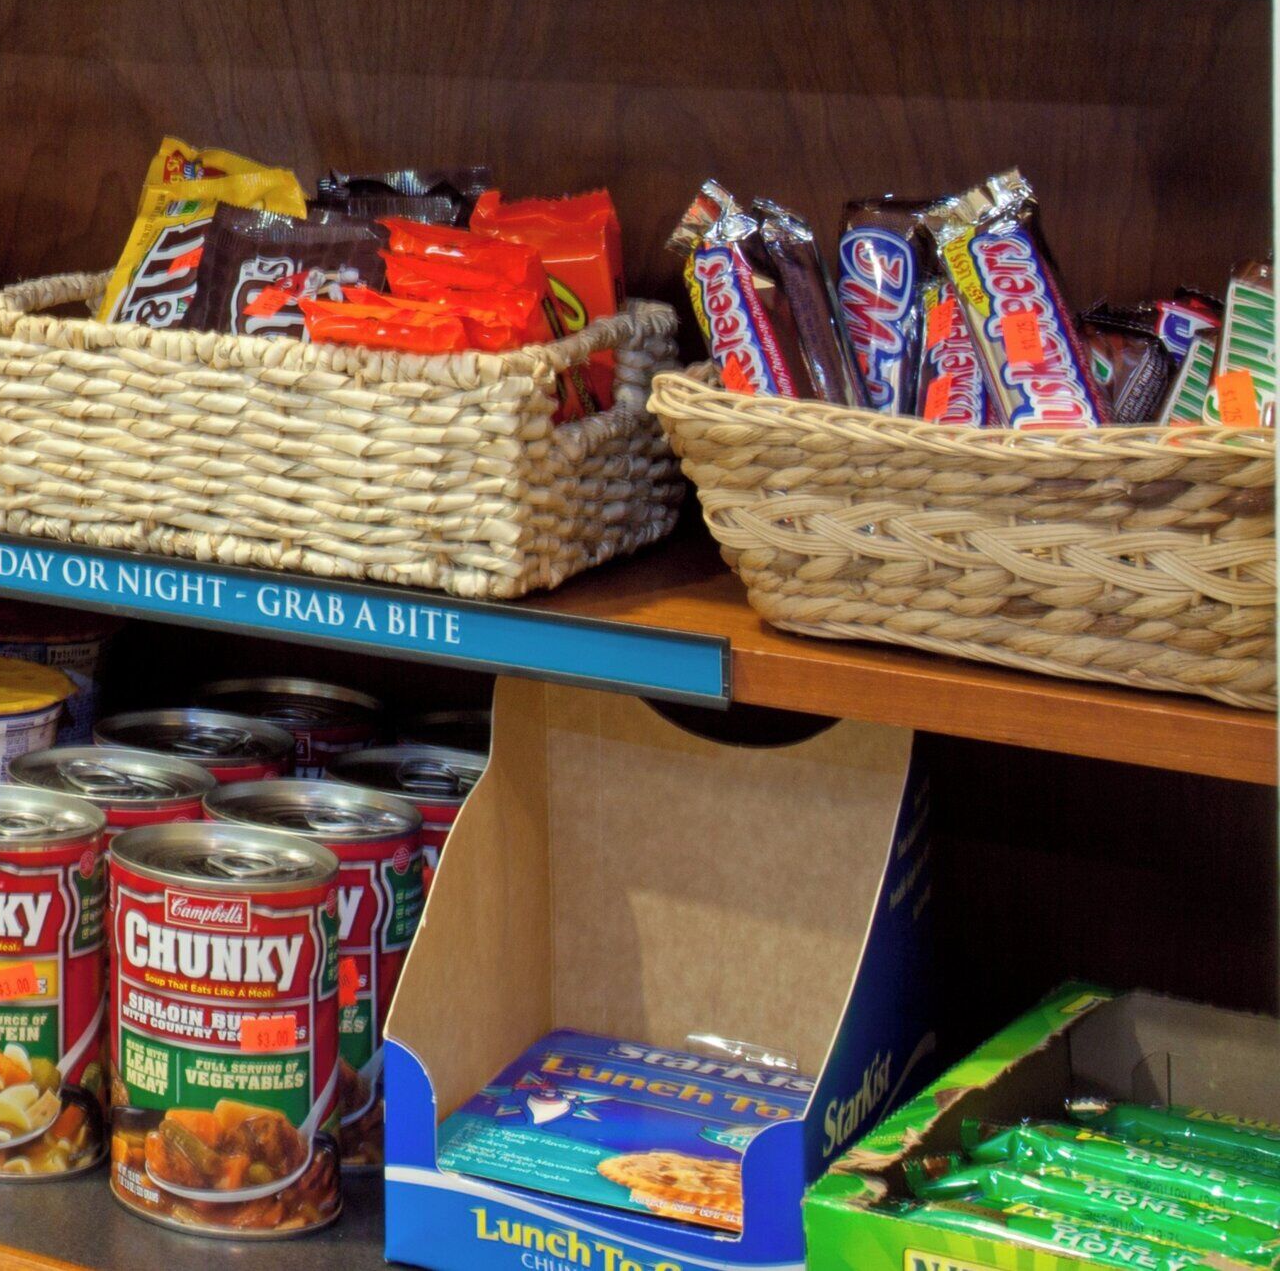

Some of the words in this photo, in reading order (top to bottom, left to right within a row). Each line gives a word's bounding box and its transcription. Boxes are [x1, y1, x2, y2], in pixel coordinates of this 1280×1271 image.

[62, 557, 109, 592] OR
[118, 564, 227, 608] NIGHT
[257, 586, 344, 626] GRAB
[355, 599, 377, 631] A
[388, 603, 461, 645] BITE
[124, 910, 304, 992] CHUNKY
[32, 1013, 47, 1025] OF
[122, 1005, 147, 1024] WITH
[150, 1017, 213, 1040] COUNTRY
[128, 992, 205, 1027] SIRLOIN
[146, 1045, 169, 1058] WITH
[257, 1030, 289, 1048] $3.00
[126, 1051, 168, 1075] LEAN
[195, 1059, 227, 1073] FULL
[230, 1061, 282, 1074] SERVING
[285, 1061, 299, 1073] OF
[126, 1069, 169, 1095] MEAT
[185, 1069, 306, 1091] VEGETABLES
[540, 1054, 714, 1105] Lunch
[724, 1093, 791, 1120] To
[823, 1050, 893, 1156] StarKist
[470, 1207, 591, 1268] Lunch
